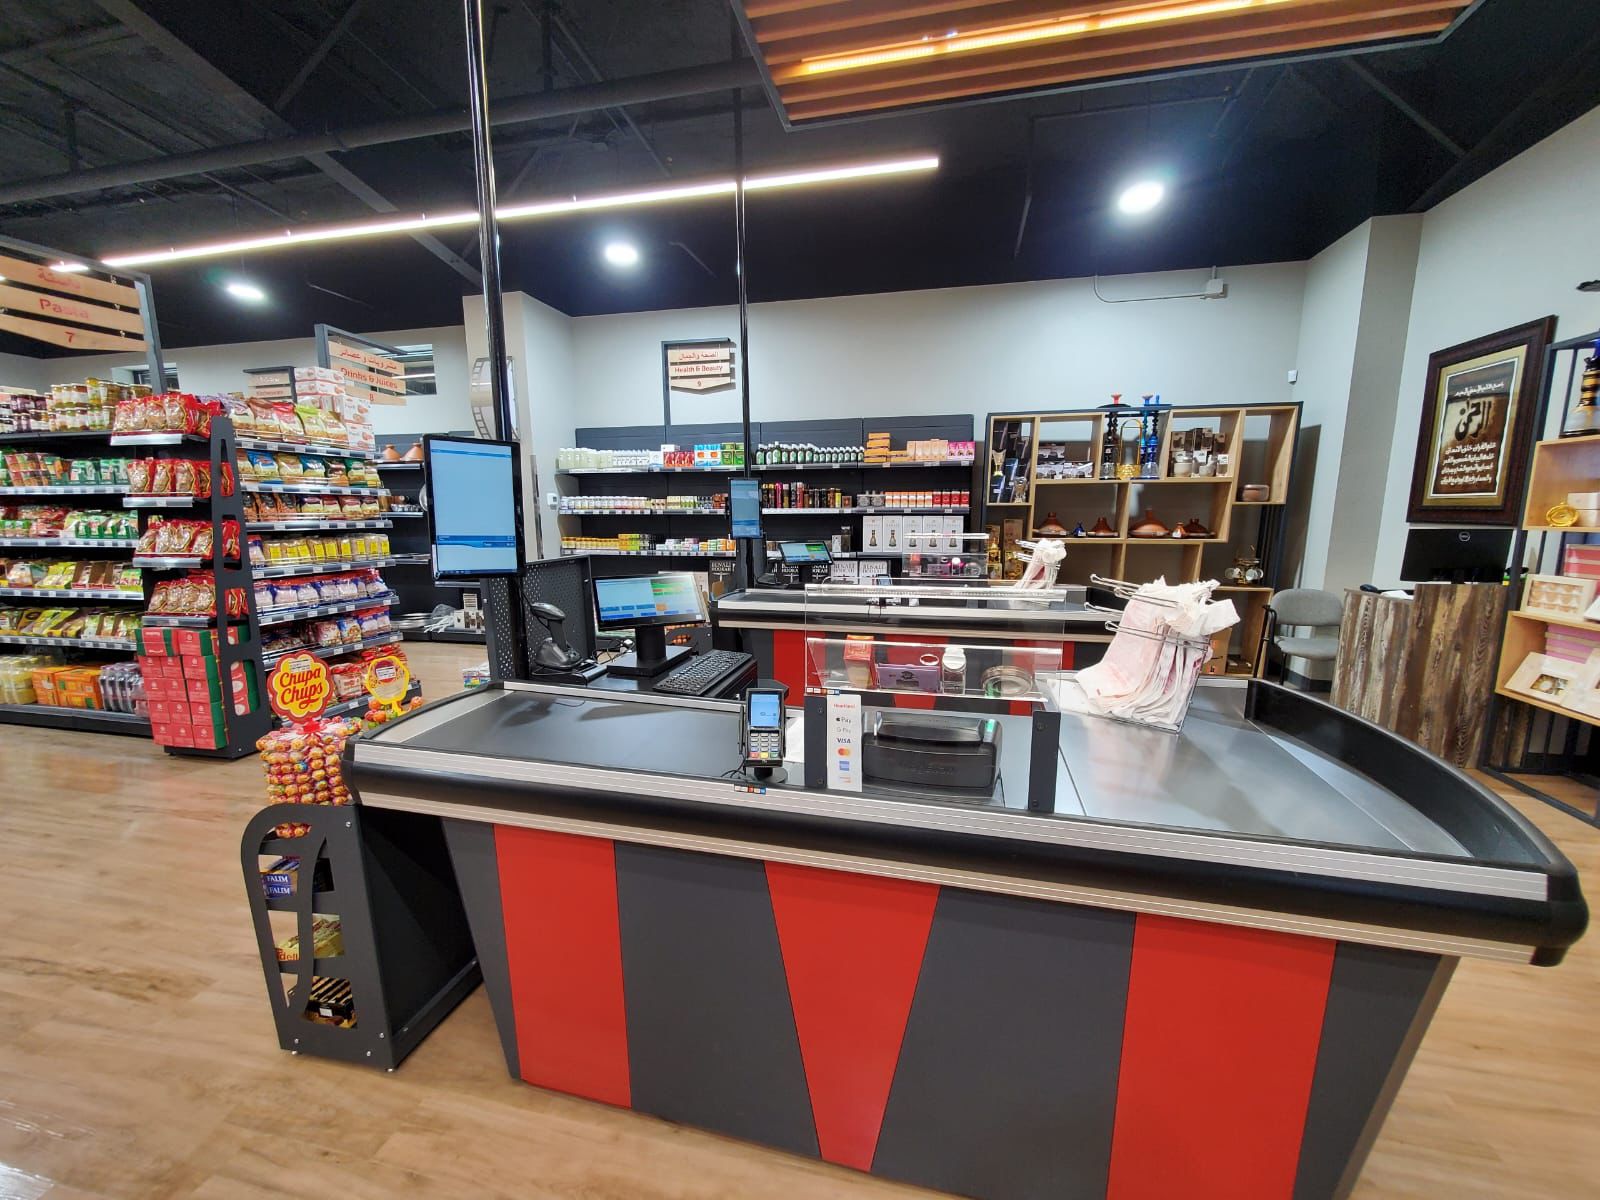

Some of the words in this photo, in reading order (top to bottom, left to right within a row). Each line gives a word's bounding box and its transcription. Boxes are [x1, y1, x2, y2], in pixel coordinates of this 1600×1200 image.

[64, 331, 75, 343] 7
[674, 365, 694, 373] Health
[341, 367, 367, 381] Drinks
[376, 376, 398, 389] Juices
[280, 667, 321, 687] Chupa
[281, 682, 323, 709] Chups
[266, 875, 289, 883] FALIM
[269, 887, 291, 895] FALIM
